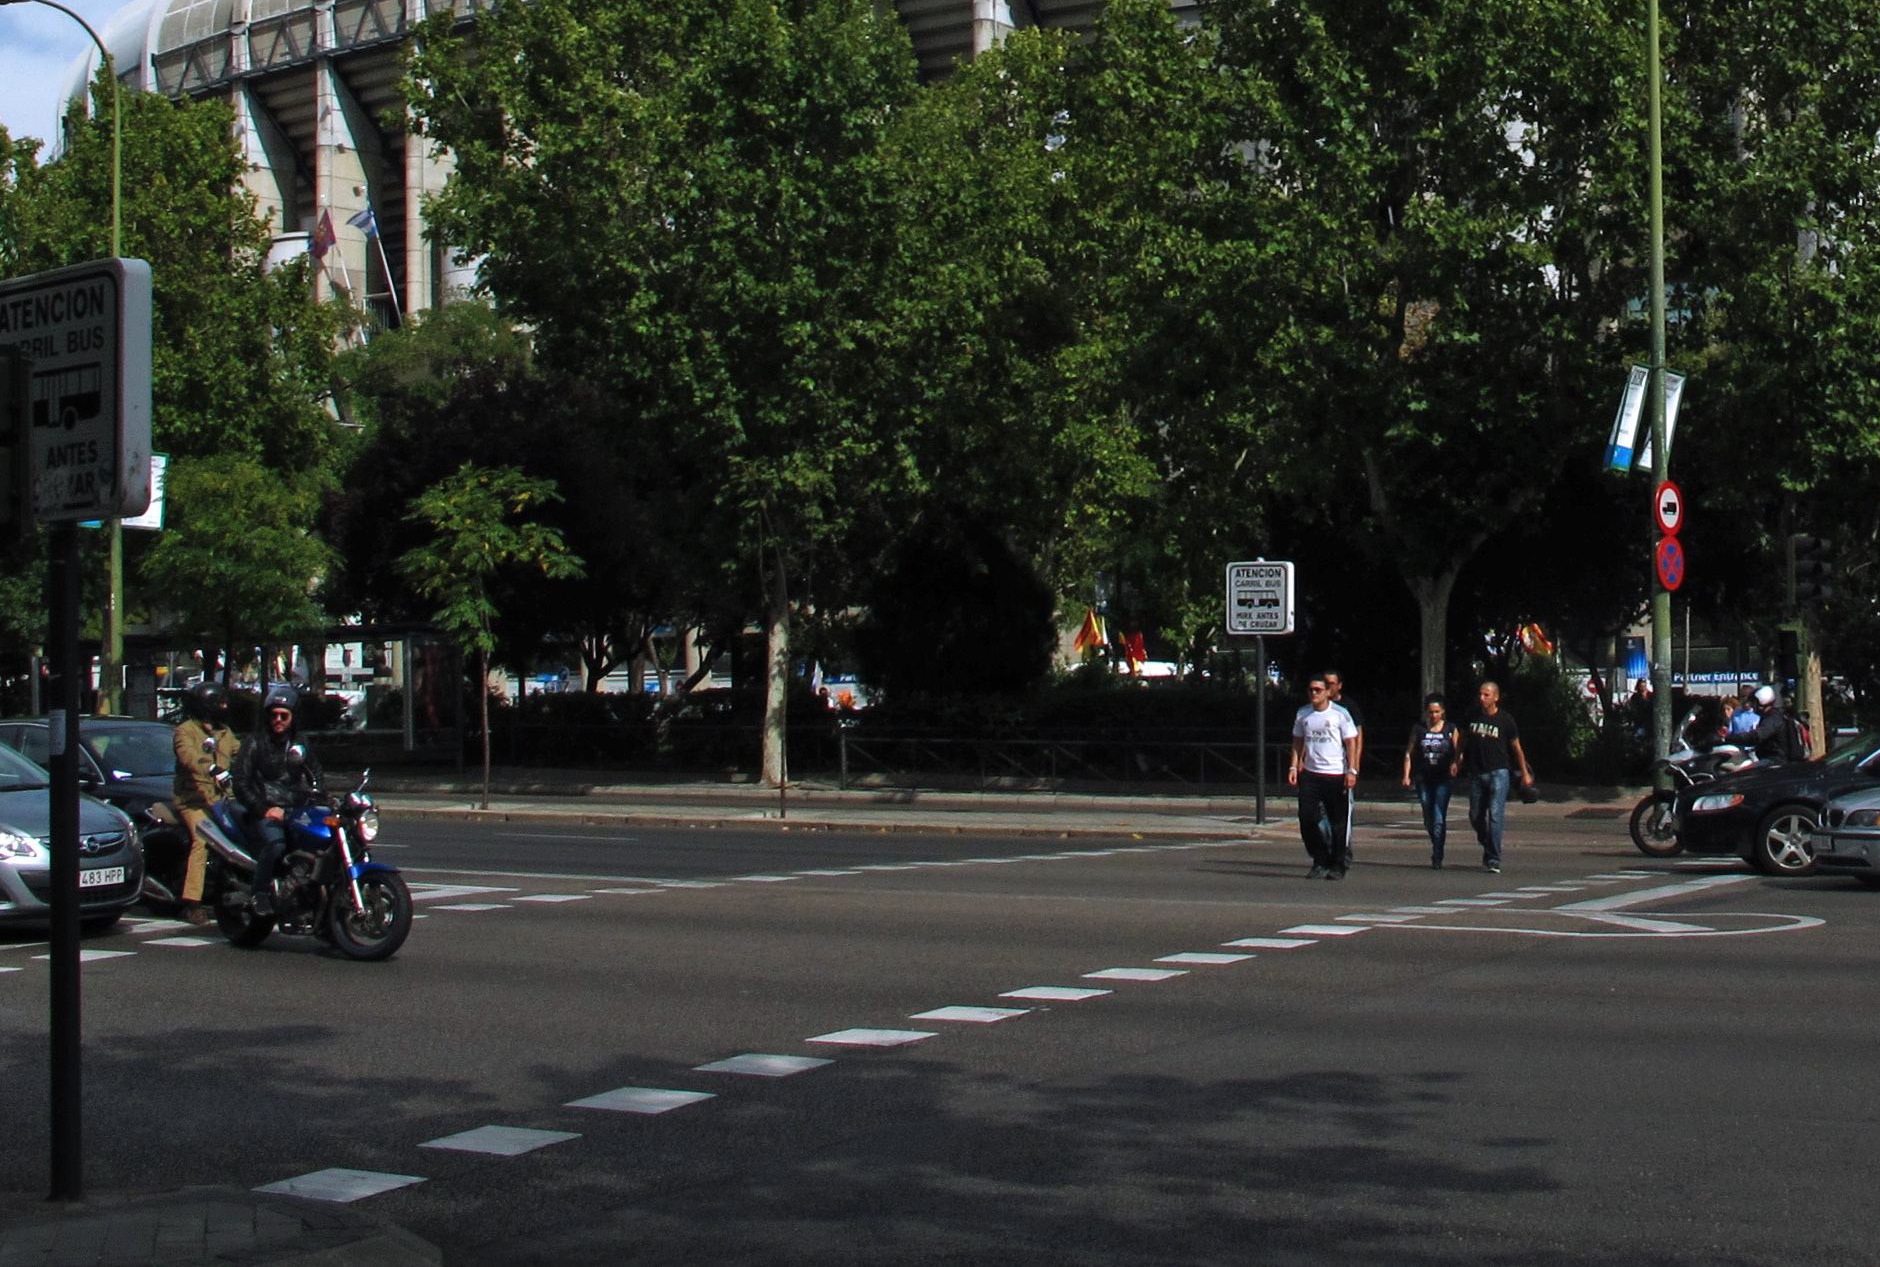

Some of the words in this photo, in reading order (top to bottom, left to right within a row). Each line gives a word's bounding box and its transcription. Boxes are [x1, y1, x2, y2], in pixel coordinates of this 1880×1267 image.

[0, 284, 105, 333] ATENCION
[12, 336, 59, 359] RRIL
[67, 326, 104, 353] BUS
[47, 440, 98, 468] ANTES
[1236, 569, 1281, 578] ATENCION
[104, 869, 122, 883] HPP
